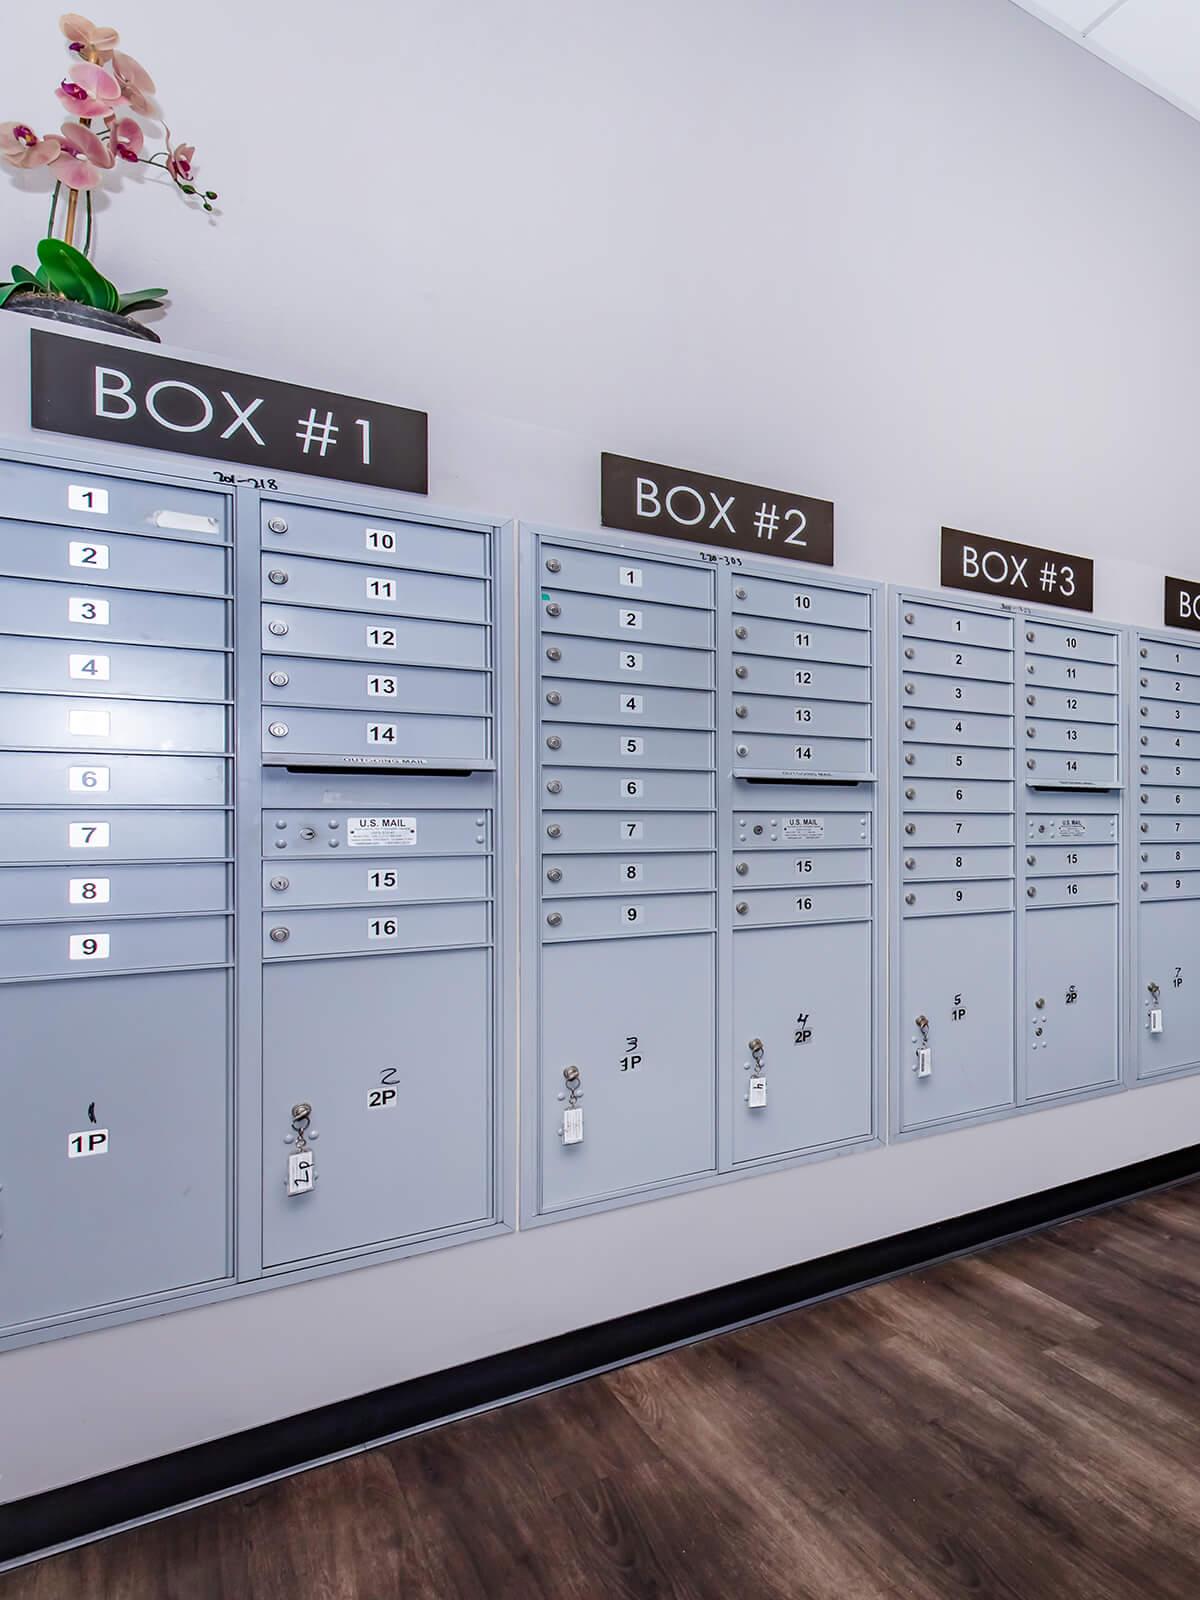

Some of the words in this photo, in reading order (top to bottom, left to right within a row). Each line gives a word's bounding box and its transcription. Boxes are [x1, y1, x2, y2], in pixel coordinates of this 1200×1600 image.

[93, 365, 267, 447] BOX
[295, 408, 370, 465] #1
[82, 491, 93, 509] 1
[636, 477, 737, 534] BOX
[753, 502, 807, 547] #2
[369, 532, 394, 550] 10
[81, 547, 97, 565] 2
[626, 570, 634, 585] 1
[963, 545, 1029, 588] BOX
[1039, 561, 1076, 597] #3
[370, 581, 391, 598] 11
[795, 595, 811, 609] 10
[81, 602, 97, 620] 3
[626, 612, 637, 627] 2
[370, 630, 395, 646] 12
[796, 633, 809, 647] 11
[1066, 637, 1077, 649] 10
[81, 659, 99, 676] 4
[626, 654, 636, 668] 3
[795, 671, 812, 685] 12
[1066, 668, 1076, 679] 11
[370, 678, 395, 694] 13
[626, 697, 637, 711] 4
[1067, 699, 1078, 710] 12
[795, 709, 812, 722] 13
[370, 726, 395, 742] 14
[955, 721, 963, 733] 4
[1066, 730, 1078, 741] 13
[627, 739, 637, 753] 5
[795, 747, 812, 760] 14
[956, 755, 963, 767] 5
[1066, 761, 1077, 771] 14
[81, 770, 98, 788] 6
[627, 781, 637, 795] 6
[956, 789, 963, 801] 6
[359, 818, 377, 828] U.S.
[382, 819, 406, 828] MAIL
[626, 823, 637, 837] 7
[955, 823, 963, 834] 7
[81, 827, 97, 844] 7
[955, 856, 963, 868] 8
[1066, 853, 1078, 865] 15
[626, 865, 637, 880] 8
[796, 860, 813, 873] 15
[371, 872, 396, 888] 15
[81, 882, 97, 900] 8
[956, 890, 963, 902] 9
[1067, 884, 1078, 895] 16
[796, 897, 812, 911] 16
[627, 907, 637, 922] 9
[371, 920, 396, 936] 16
[82, 938, 98, 956] 9
[1173, 977, 1183, 988] 1P
[1065, 992, 1078, 1004] 2P
[797, 1013, 810, 1029] 4
[952, 1008, 966, 1021] 1P
[795, 1030, 812, 1044] 2P
[626, 1036, 638, 1053] 3
[380, 1067, 401, 1086] 2
[369, 1089, 396, 1108] 2P
[71, 1133, 107, 1153] 1P
